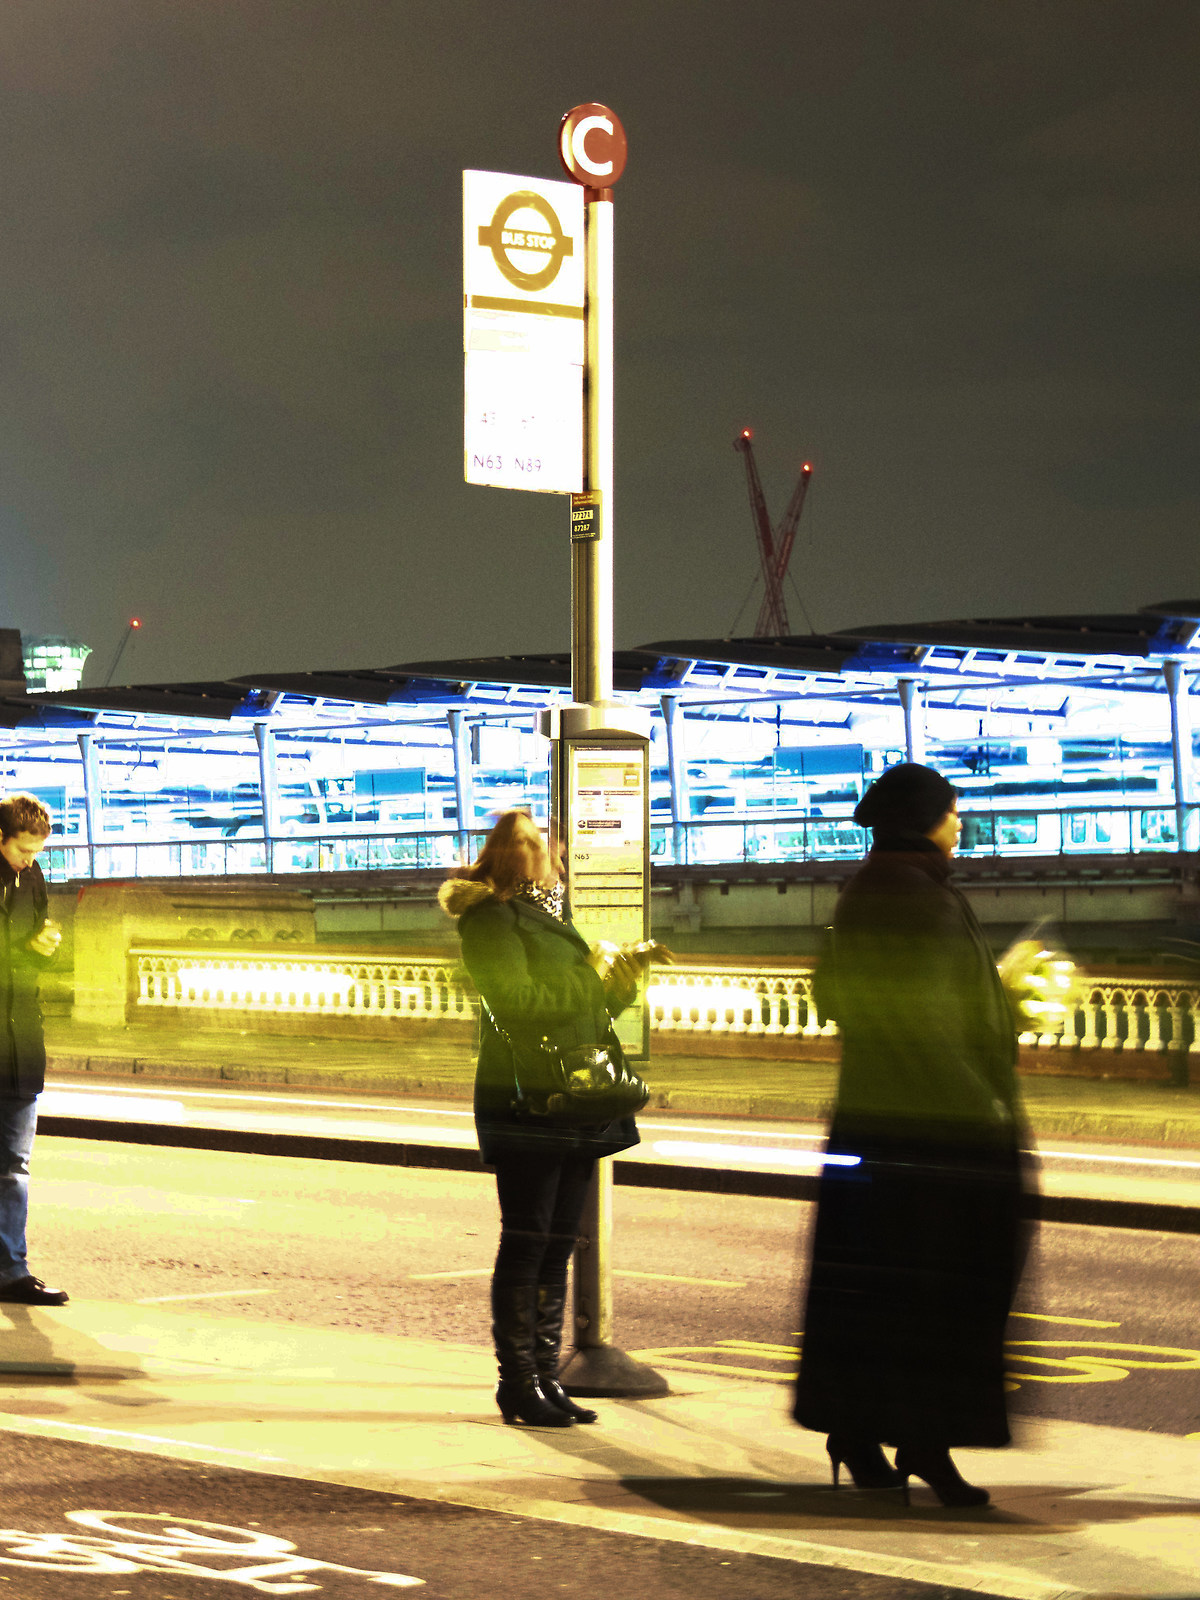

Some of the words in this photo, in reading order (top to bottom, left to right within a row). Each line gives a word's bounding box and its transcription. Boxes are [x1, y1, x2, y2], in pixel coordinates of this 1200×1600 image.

[571, 115, 612, 176] C
[501, 231, 526, 247] BUS
[526, 235, 557, 250] STOP
[472, 454, 503, 471] N63
[514, 456, 542, 473] N89
[574, 853, 590, 861] N63
